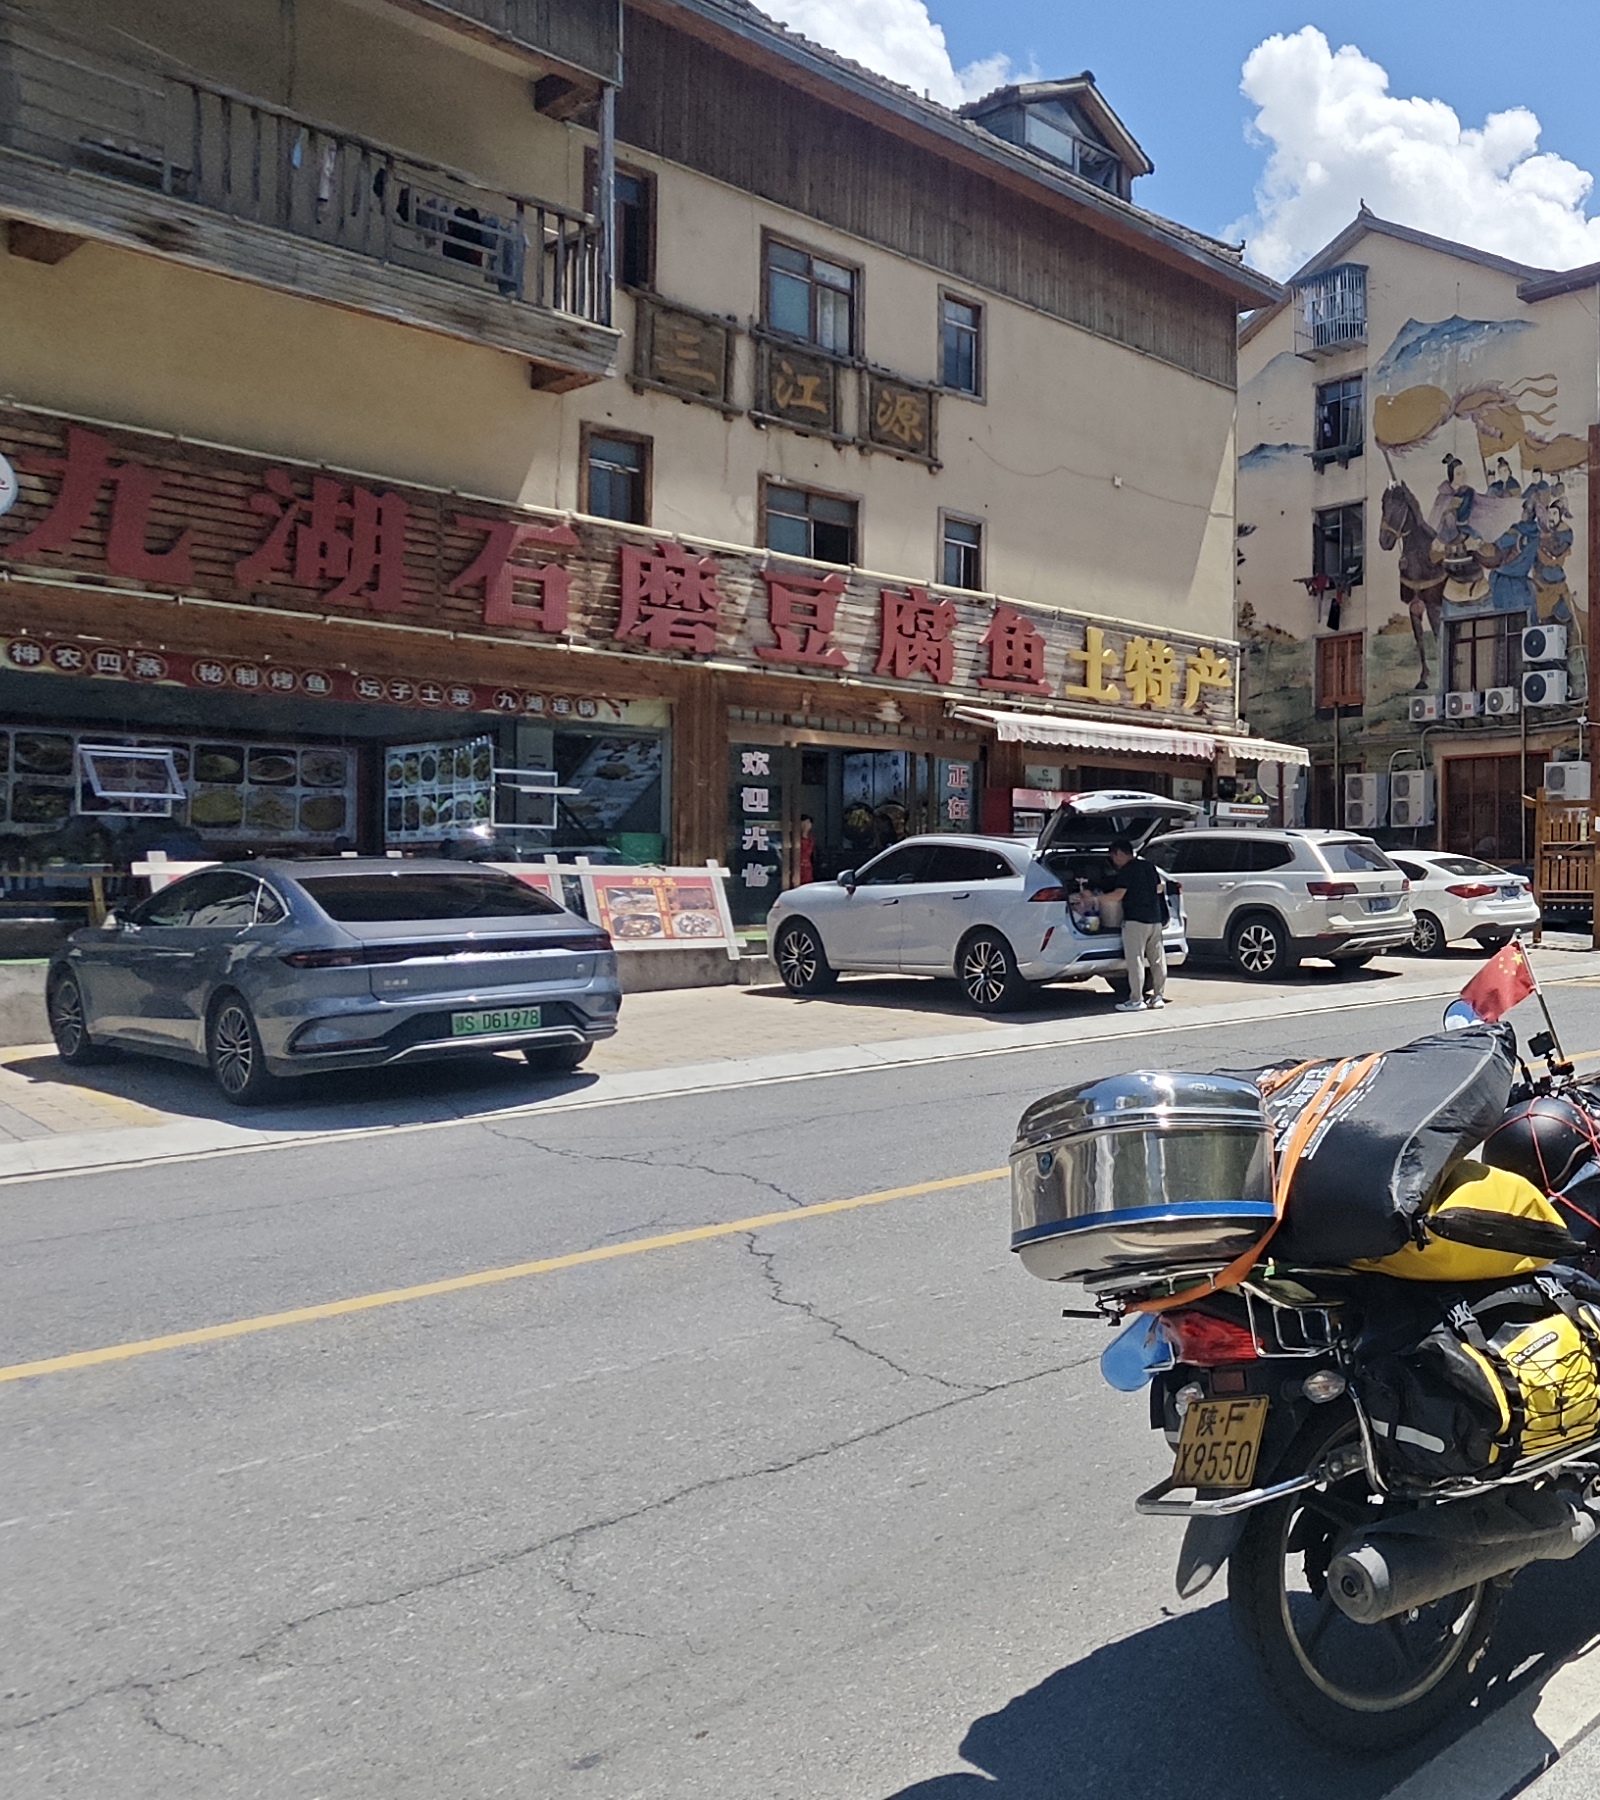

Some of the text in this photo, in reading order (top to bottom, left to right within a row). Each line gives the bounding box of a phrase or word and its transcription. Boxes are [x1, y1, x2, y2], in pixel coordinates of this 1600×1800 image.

[656, 331, 923, 443] 三江源
[6, 427, 1233, 710] 九湖石磨豆腐鱼 土特产
[11, 642, 597, 716] 神农四蒸 秘制烤鱼 坛子土菜 九湖连锅
[741, 751, 770, 888] 欢迎光临
[948, 764, 969, 820] 正在
